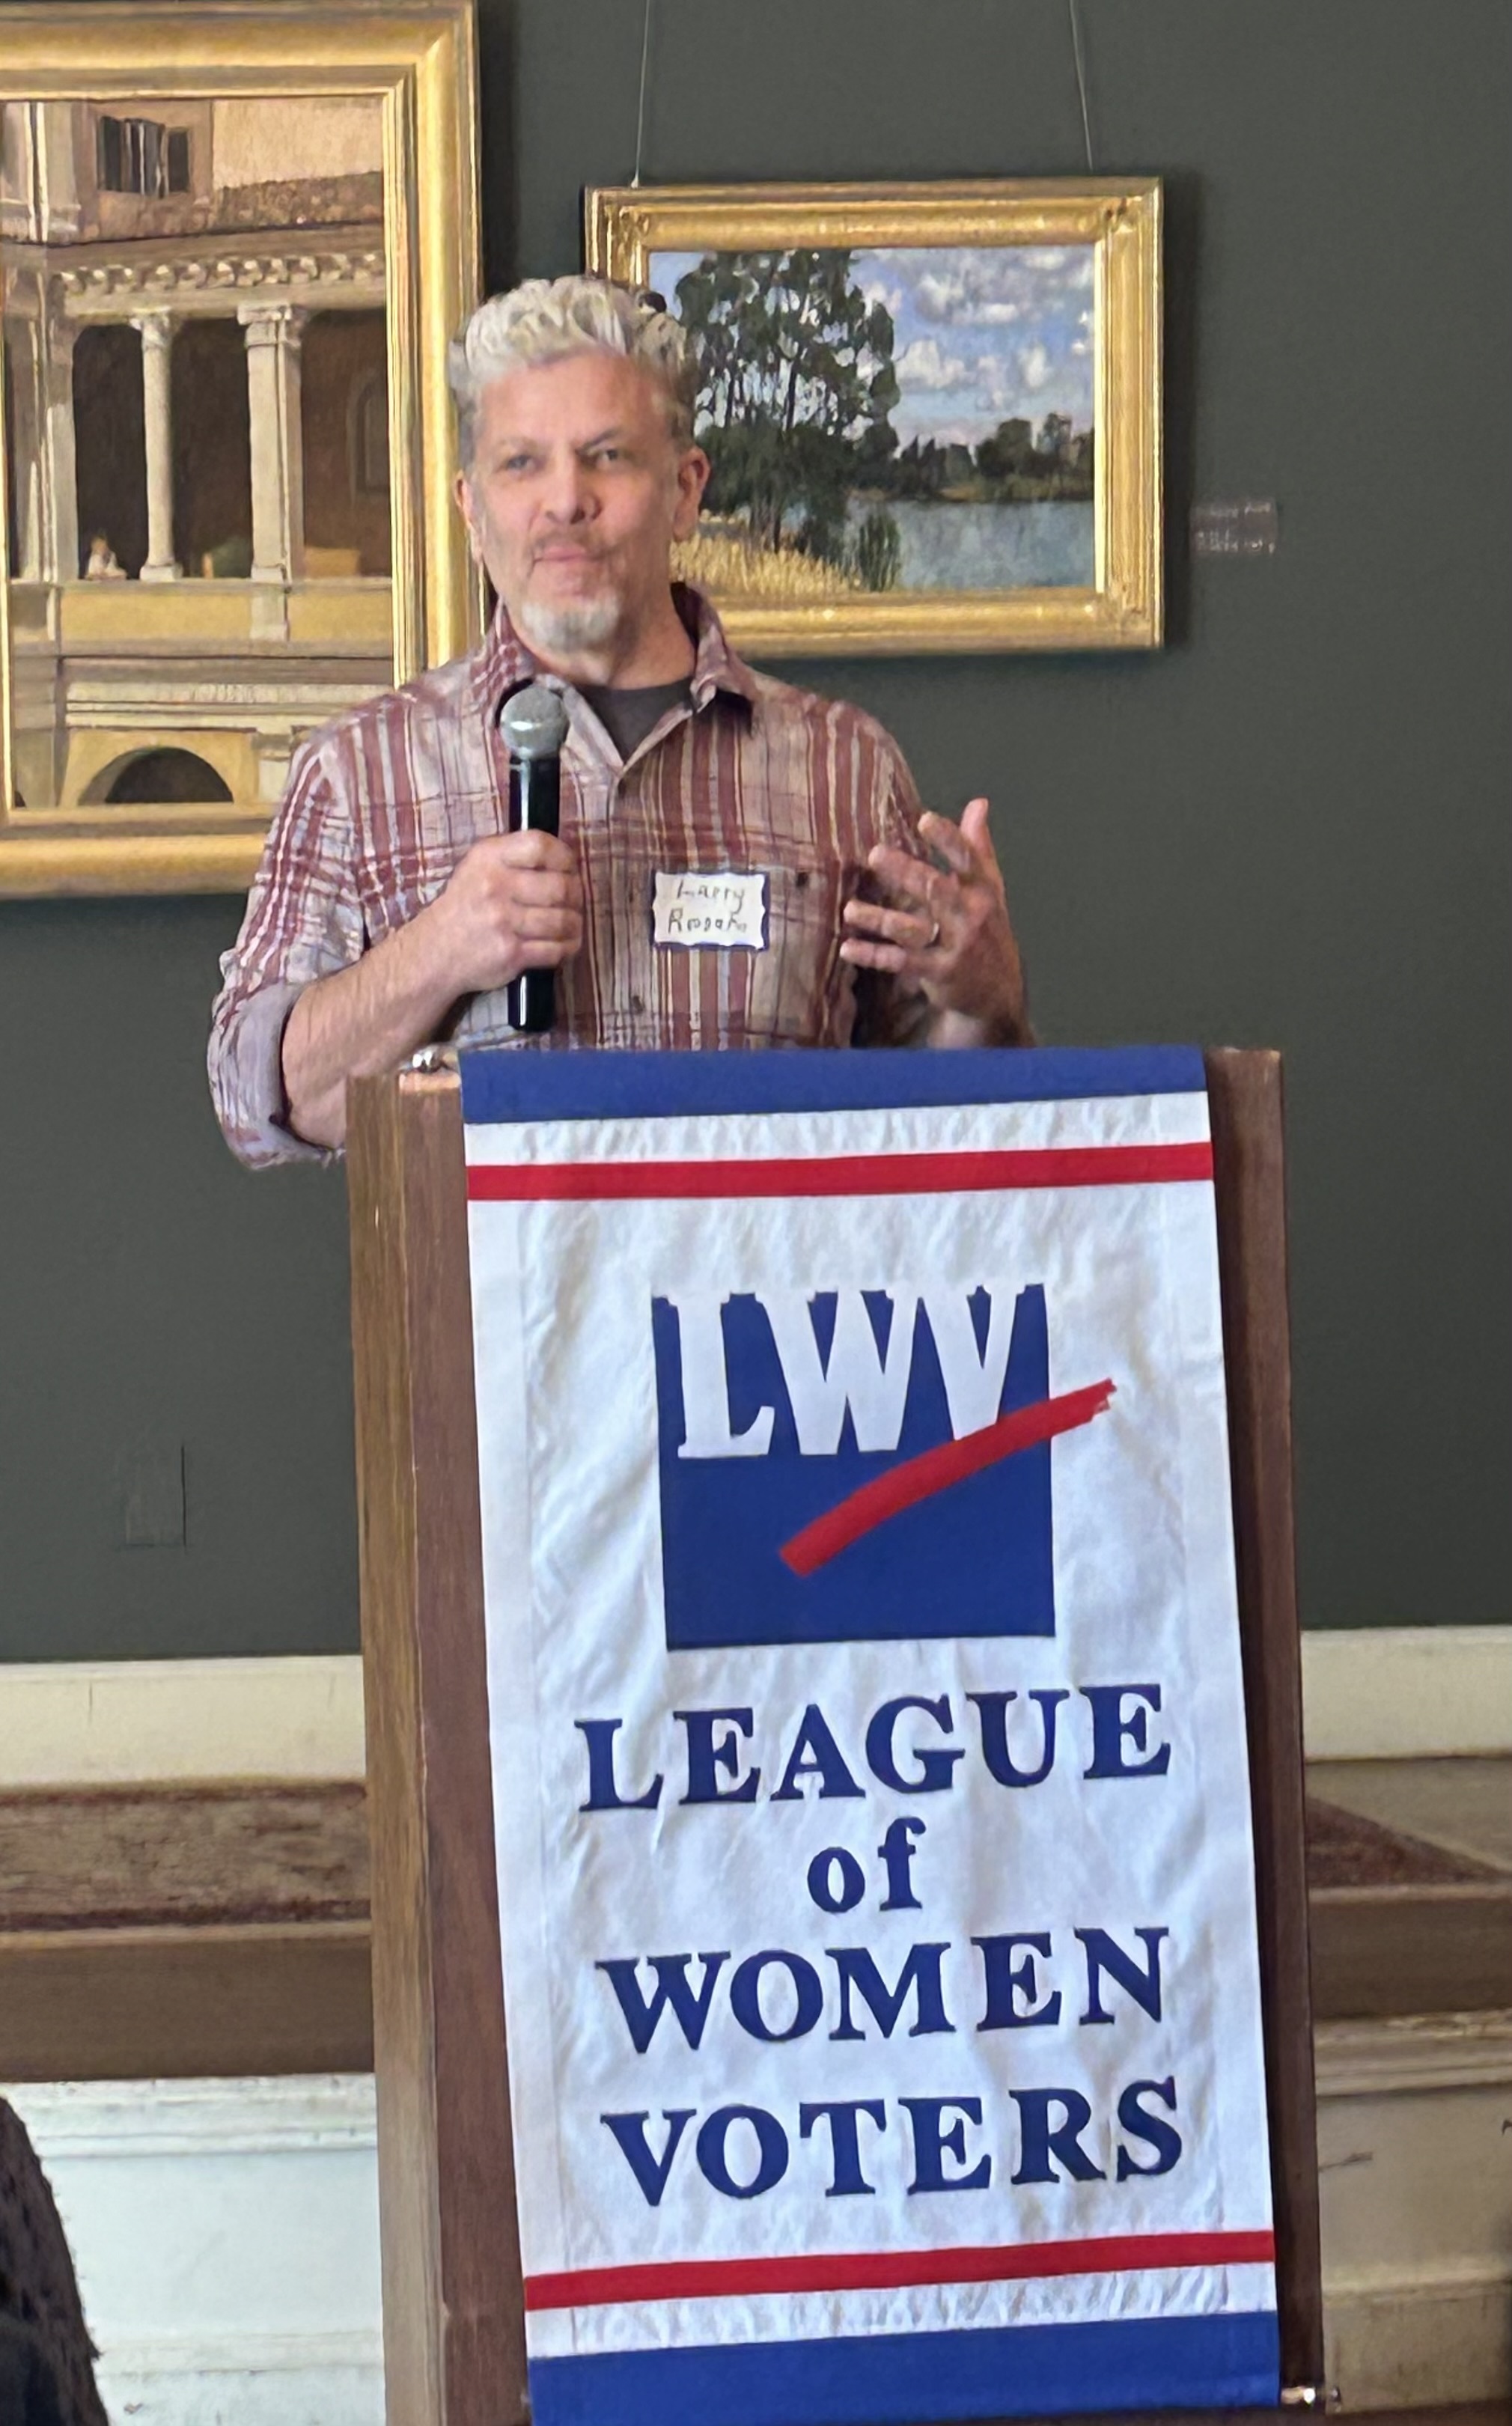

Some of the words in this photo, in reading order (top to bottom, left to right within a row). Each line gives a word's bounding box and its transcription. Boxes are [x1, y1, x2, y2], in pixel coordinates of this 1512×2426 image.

[668, 1284, 1028, 1458] LWV
[574, 1684, 1171, 1812] LEAGUE
[808, 1817, 926, 1913] of
[595, 1927, 1169, 2054] WOMEN
[600, 2076, 1182, 2207] VOTERS
